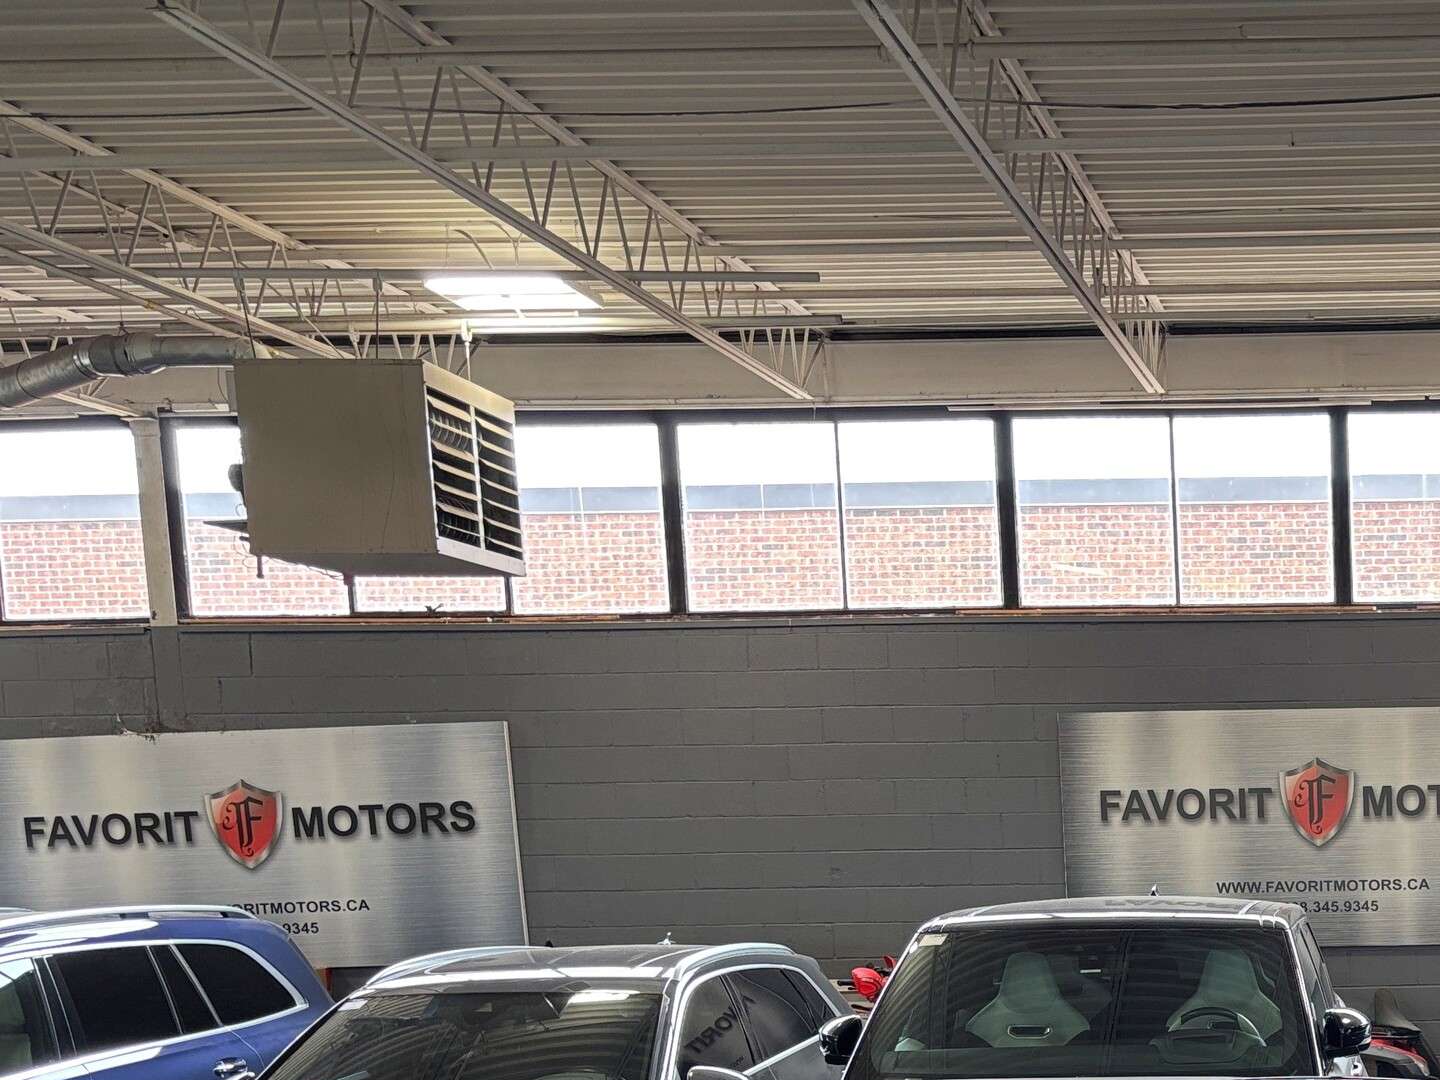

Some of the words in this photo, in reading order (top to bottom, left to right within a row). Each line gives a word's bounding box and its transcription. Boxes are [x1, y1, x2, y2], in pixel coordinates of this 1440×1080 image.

[1099, 788, 1272, 821] FAVORIT
[23, 810, 199, 849] FAVORIT
[292, 800, 477, 838] MOTORS
[1216, 878, 1430, 894] WWW.FAVORITMOTORS.CA
[1293, 900, 1379, 912] 8.345.9345
